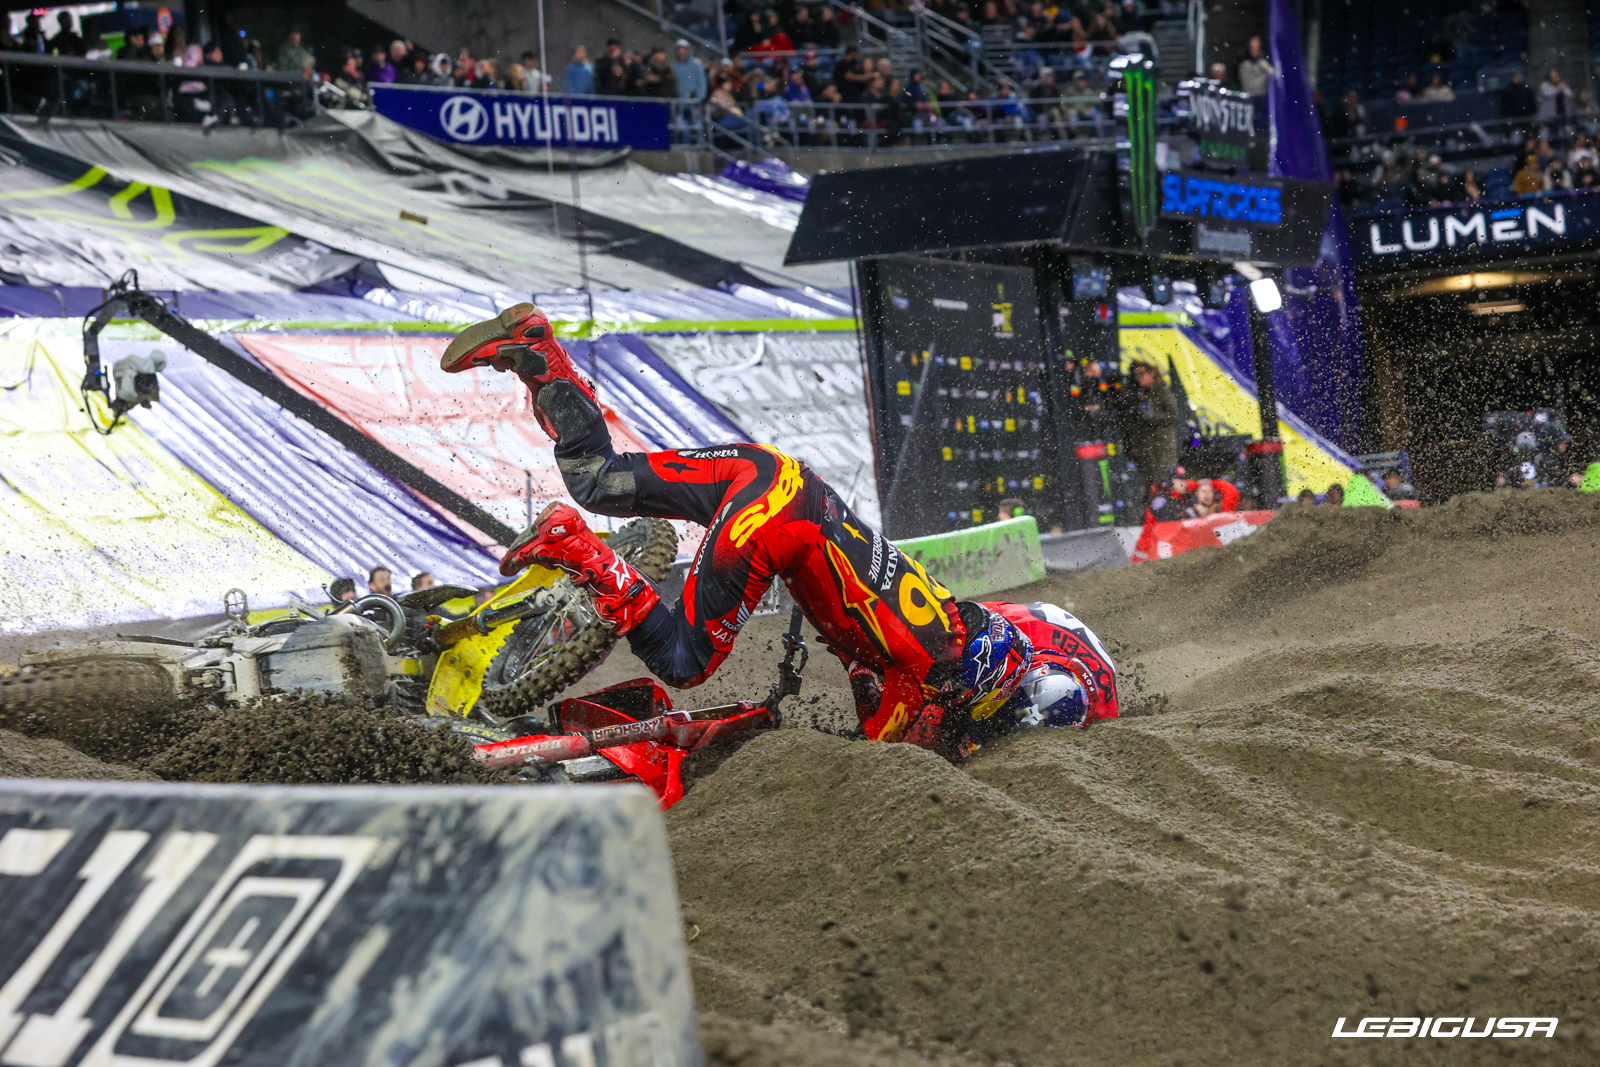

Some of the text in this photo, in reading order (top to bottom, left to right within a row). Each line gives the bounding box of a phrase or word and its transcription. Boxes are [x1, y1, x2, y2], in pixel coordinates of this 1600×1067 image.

[493, 102, 619, 143] HYUNDAI
[1189, 93, 1256, 137] MONSTER
[1163, 173, 1283, 225] SUPERCROSS
[1369, 203, 1567, 255] LUMEN
[694, 449, 739, 459] HONDA
[693, 517, 722, 576] HONDA
[1052, 628, 1114, 705] ROCZEN
[1081, 672, 1096, 692] FOX
